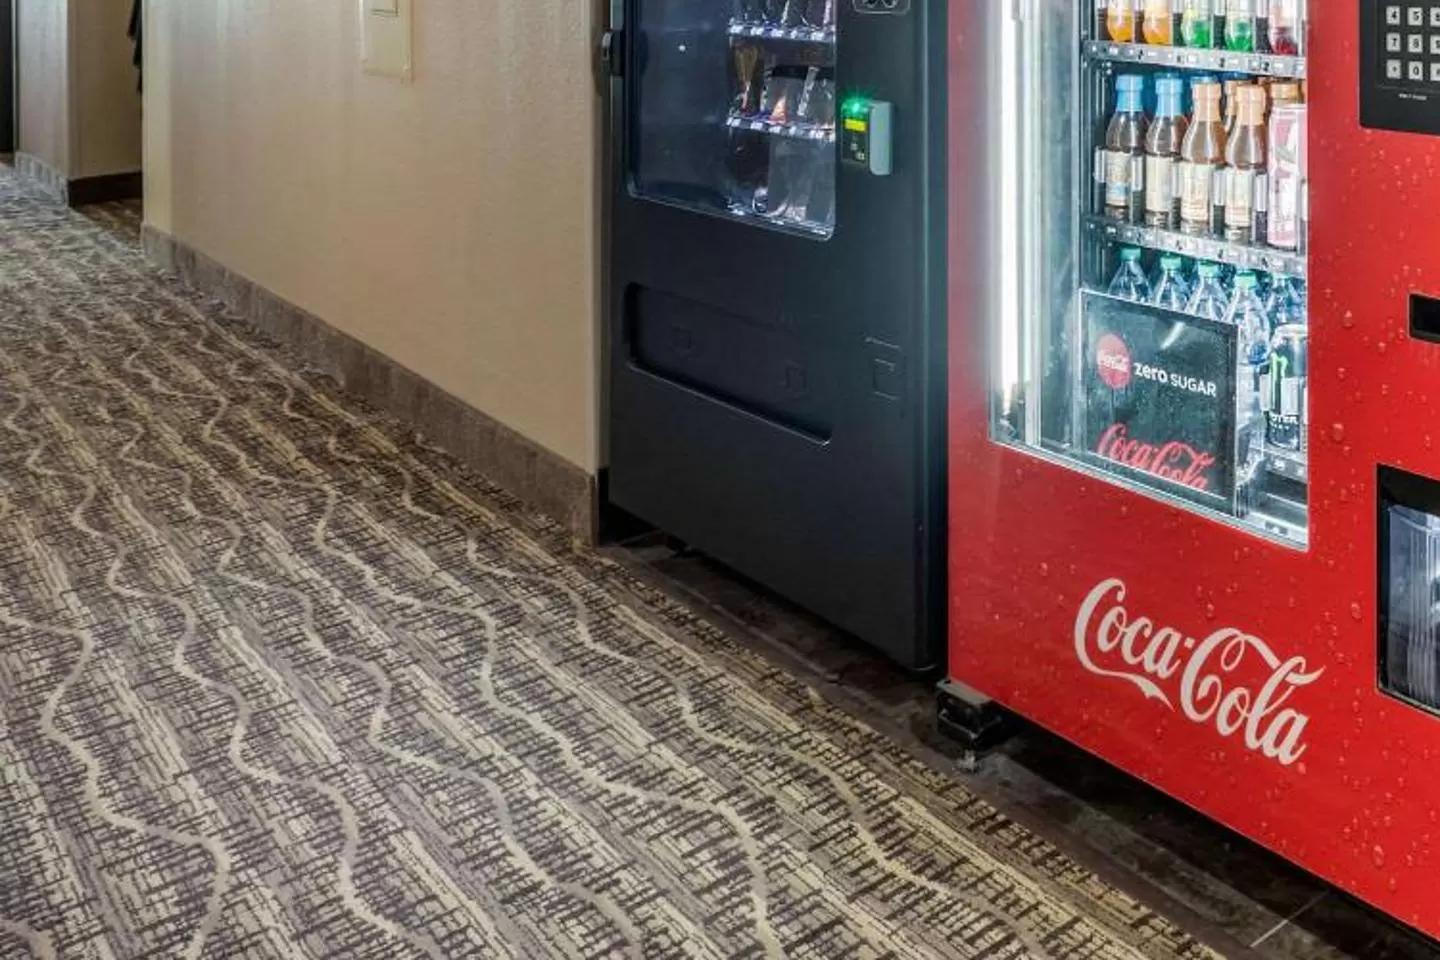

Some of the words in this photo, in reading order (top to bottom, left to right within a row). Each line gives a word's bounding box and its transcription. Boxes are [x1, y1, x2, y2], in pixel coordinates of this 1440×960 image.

[1133, 362, 1168, 383] zero
[1170, 373, 1217, 397] SUGAR
[1074, 577, 1326, 765] Coca-Cola
